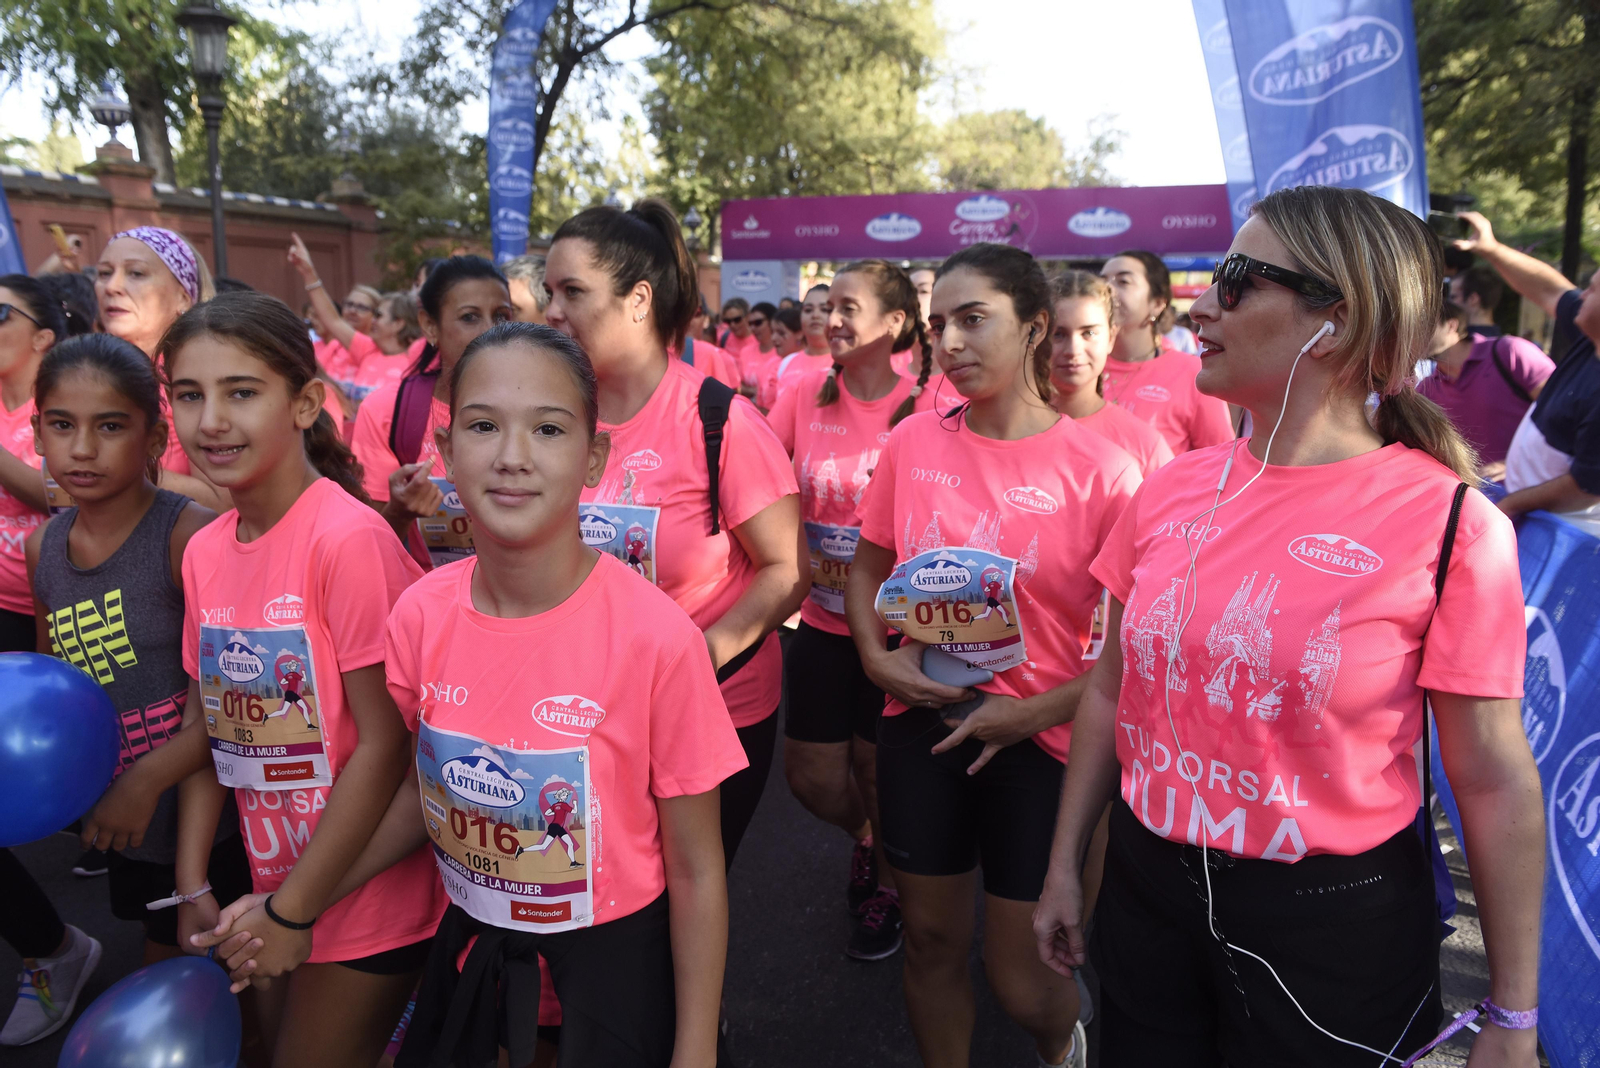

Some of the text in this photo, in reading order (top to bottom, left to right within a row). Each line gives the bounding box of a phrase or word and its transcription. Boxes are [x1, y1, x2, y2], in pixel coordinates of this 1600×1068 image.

[1161, 214, 1217, 230] OYSHO
[730, 229, 771, 240] Santander
[795, 224, 839, 238] OYSHO
[809, 421, 847, 436] OYSHO
[910, 467, 961, 488] OYSHO
[1007, 491, 1053, 512] ASTURIANA
[1293, 540, 1375, 572] ASTURIANA
[1311, 541, 1376, 563] CENTRAL LECHERA
[913, 573, 968, 586] ASTURIANA
[914, 599, 972, 626] 016
[939, 630, 954, 642] 79
[941, 644, 951, 652] DE
[953, 644, 963, 652] LA
[964, 643, 991, 652] MUJER
[221, 655, 260, 674] ASTURIANA
[973, 653, 1015, 668] Santander
[223, 690, 266, 723] 016
[551, 705, 578, 714] CENTRAL
[234, 726, 254, 743] 1083
[218, 740, 287, 757] CARRERA DE LA MUJER
[278, 768, 308, 776] Santander
[458, 767, 514, 788] CENTRAL LECHERA
[1152, 740, 1309, 807] DORSAL
[446, 766, 519, 802] ASTURIANA
[450, 806, 520, 855] 016
[257, 866, 272, 876] DE
[274, 865, 286, 874] LA
[465, 851, 500, 875] 1081
[443, 853, 542, 896] CARRERA DE LA MUJER
[1295, 883, 1347, 896] OYSHO
[527, 908, 564, 918] Santander
